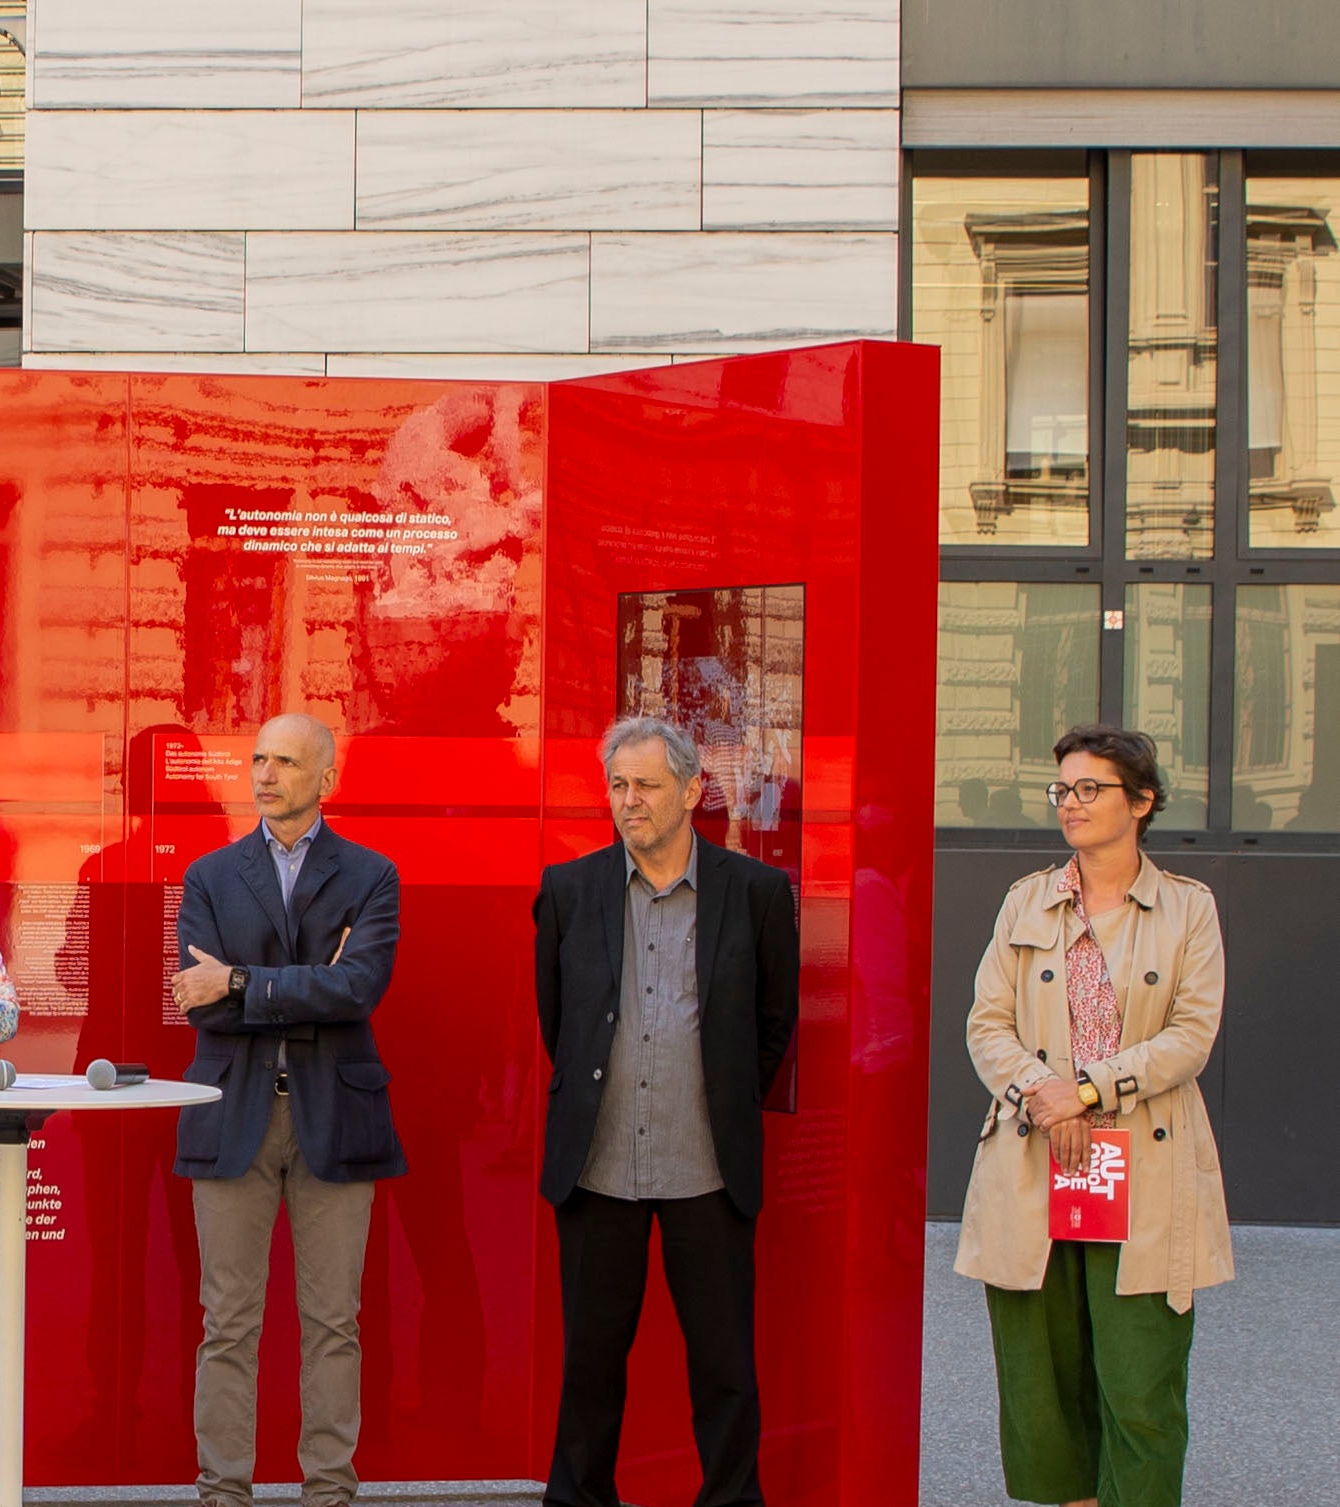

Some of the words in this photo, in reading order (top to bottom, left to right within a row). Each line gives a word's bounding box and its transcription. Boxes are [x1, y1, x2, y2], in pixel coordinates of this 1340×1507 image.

[304, 512, 327, 522] non
[330, 510, 337, 522] è
[340, 511, 393, 524] qualcosa
[395, 512, 407, 523] di
[409, 513, 451, 525] statico,
[217, 526, 236, 536] ma
[238, 524, 267, 536] deve
[269, 527, 310, 537] essere
[312, 525, 348, 538] intesa
[351, 528, 384, 538] come
[385, 529, 400, 538] un
[402, 530, 457, 540] processo
[243, 539, 298, 551] dinamico
[300, 540, 322, 552] che
[324, 541, 335, 552] si
[336, 542, 375, 553] adatta
[377, 542, 389, 553] ai
[154, 844, 175, 853] 1972
[35, 1214, 57, 1225] der
[41, 1229, 66, 1240] und
